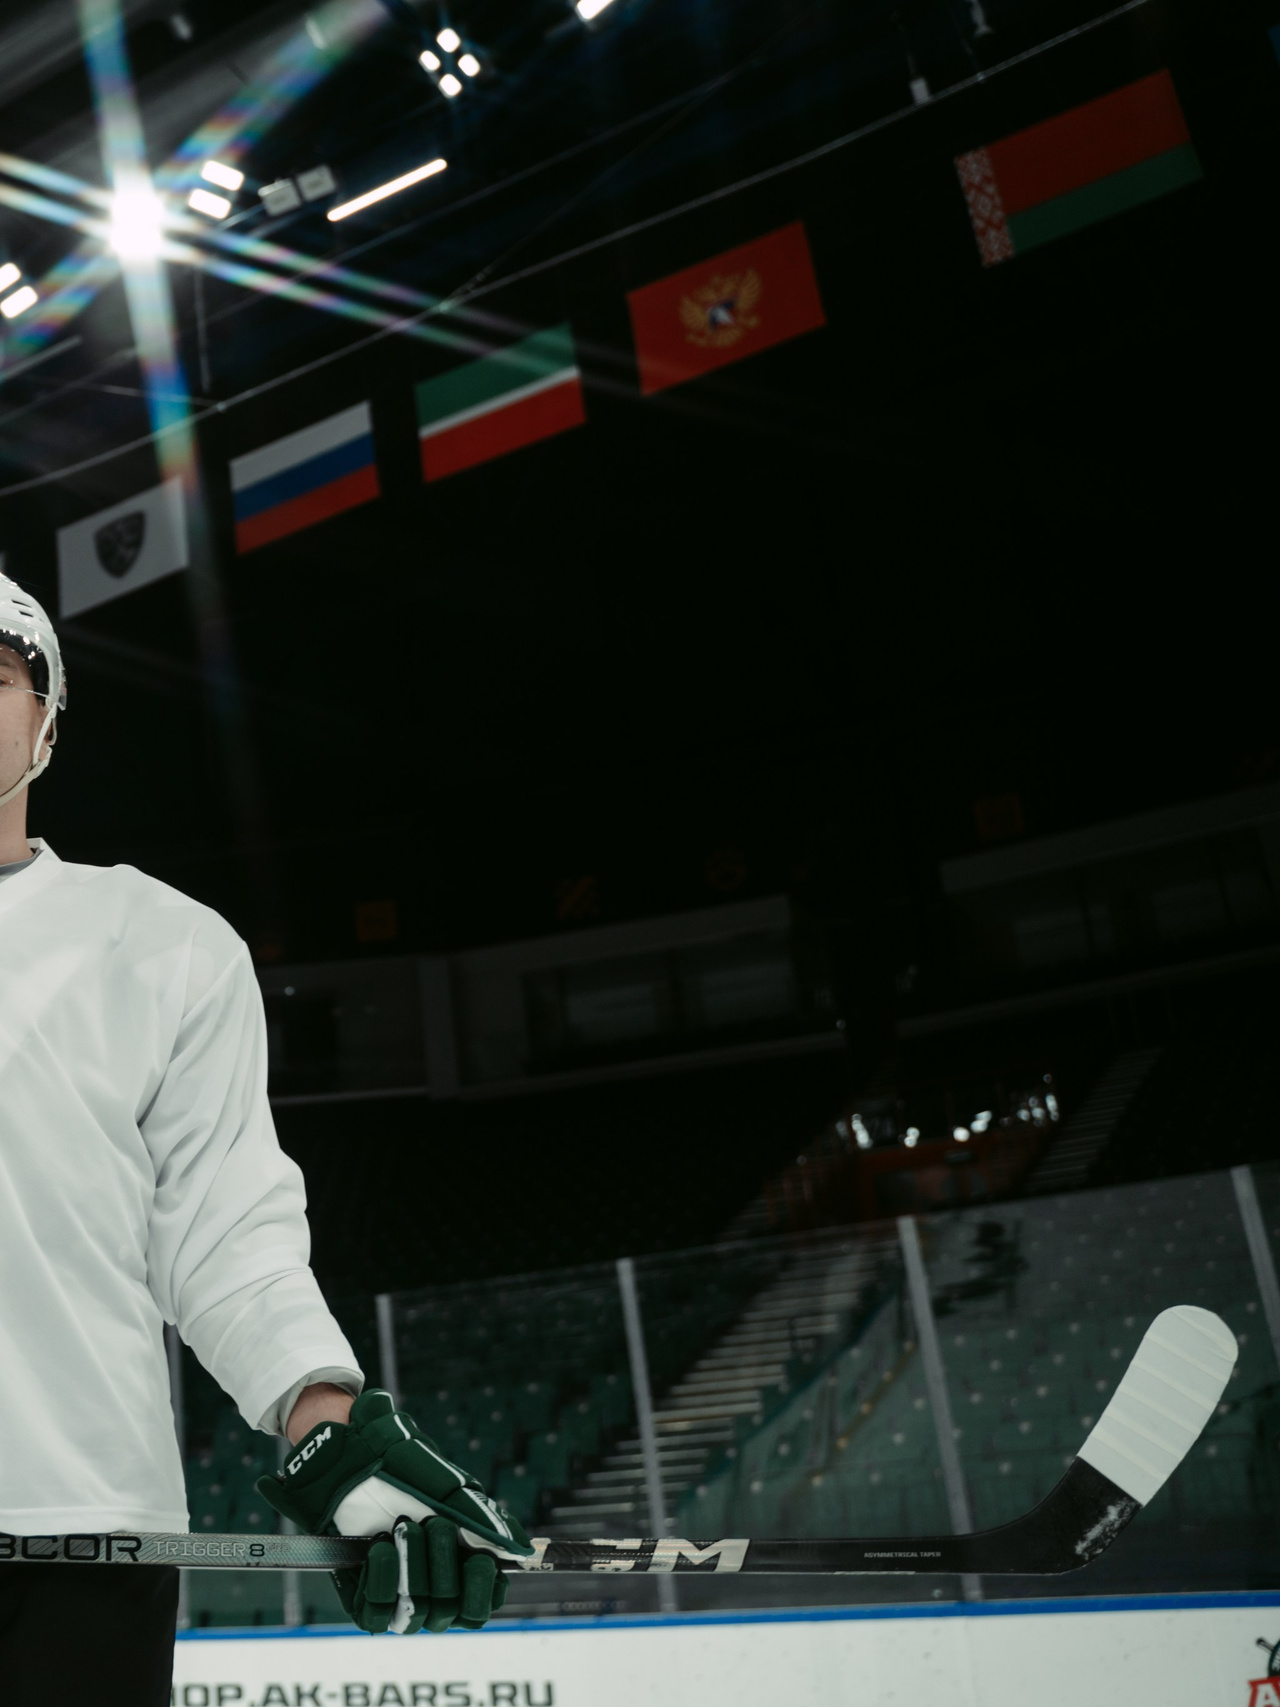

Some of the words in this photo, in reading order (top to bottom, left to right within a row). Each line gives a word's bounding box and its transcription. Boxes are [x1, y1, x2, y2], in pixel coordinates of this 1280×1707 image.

[286, 1425, 332, 1476] CCM
[152, 1541, 246, 1557] TRIGGER
[249, 1543, 265, 1557] 8
